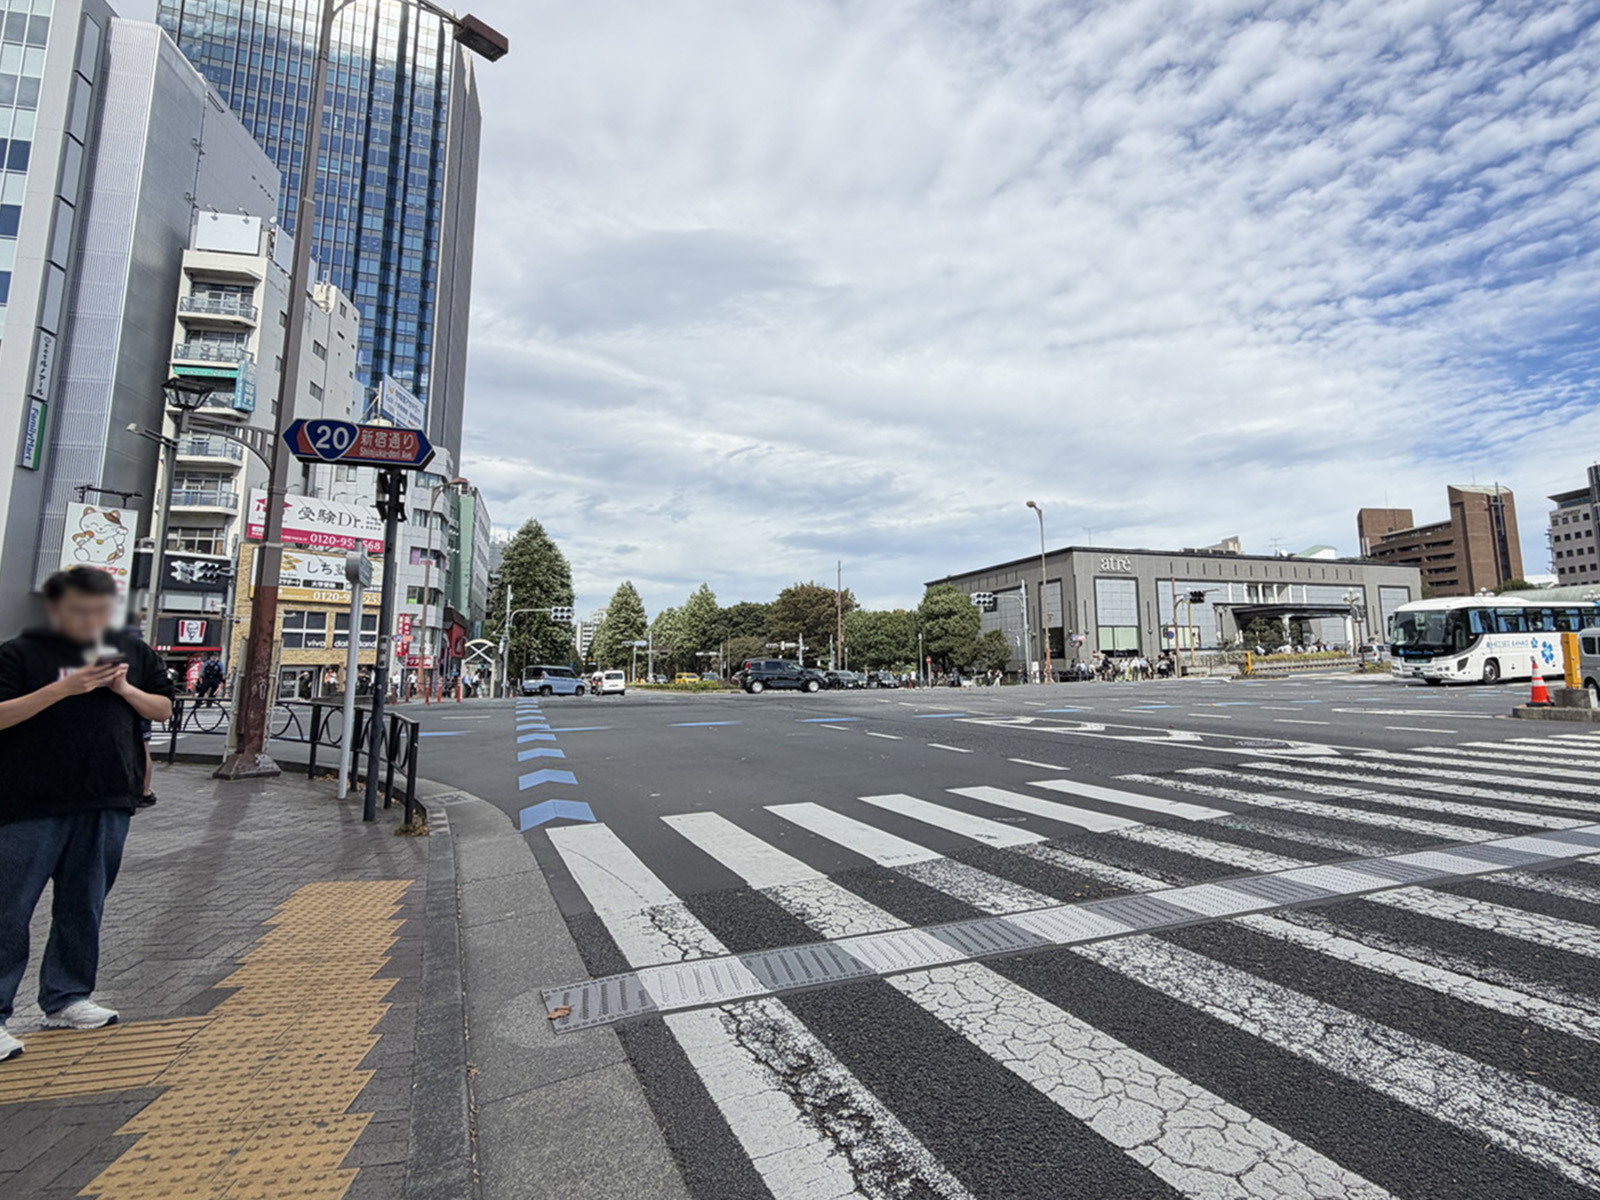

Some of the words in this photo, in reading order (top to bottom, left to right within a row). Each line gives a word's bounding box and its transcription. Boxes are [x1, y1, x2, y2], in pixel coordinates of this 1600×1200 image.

[25, 407, 39, 460] FamilyMart
[315, 425, 349, 450] 20
[360, 429, 414, 450] 新宿通り
[298, 506, 364, 529] 受験Dr.
[1100, 555, 1131, 571] atré
